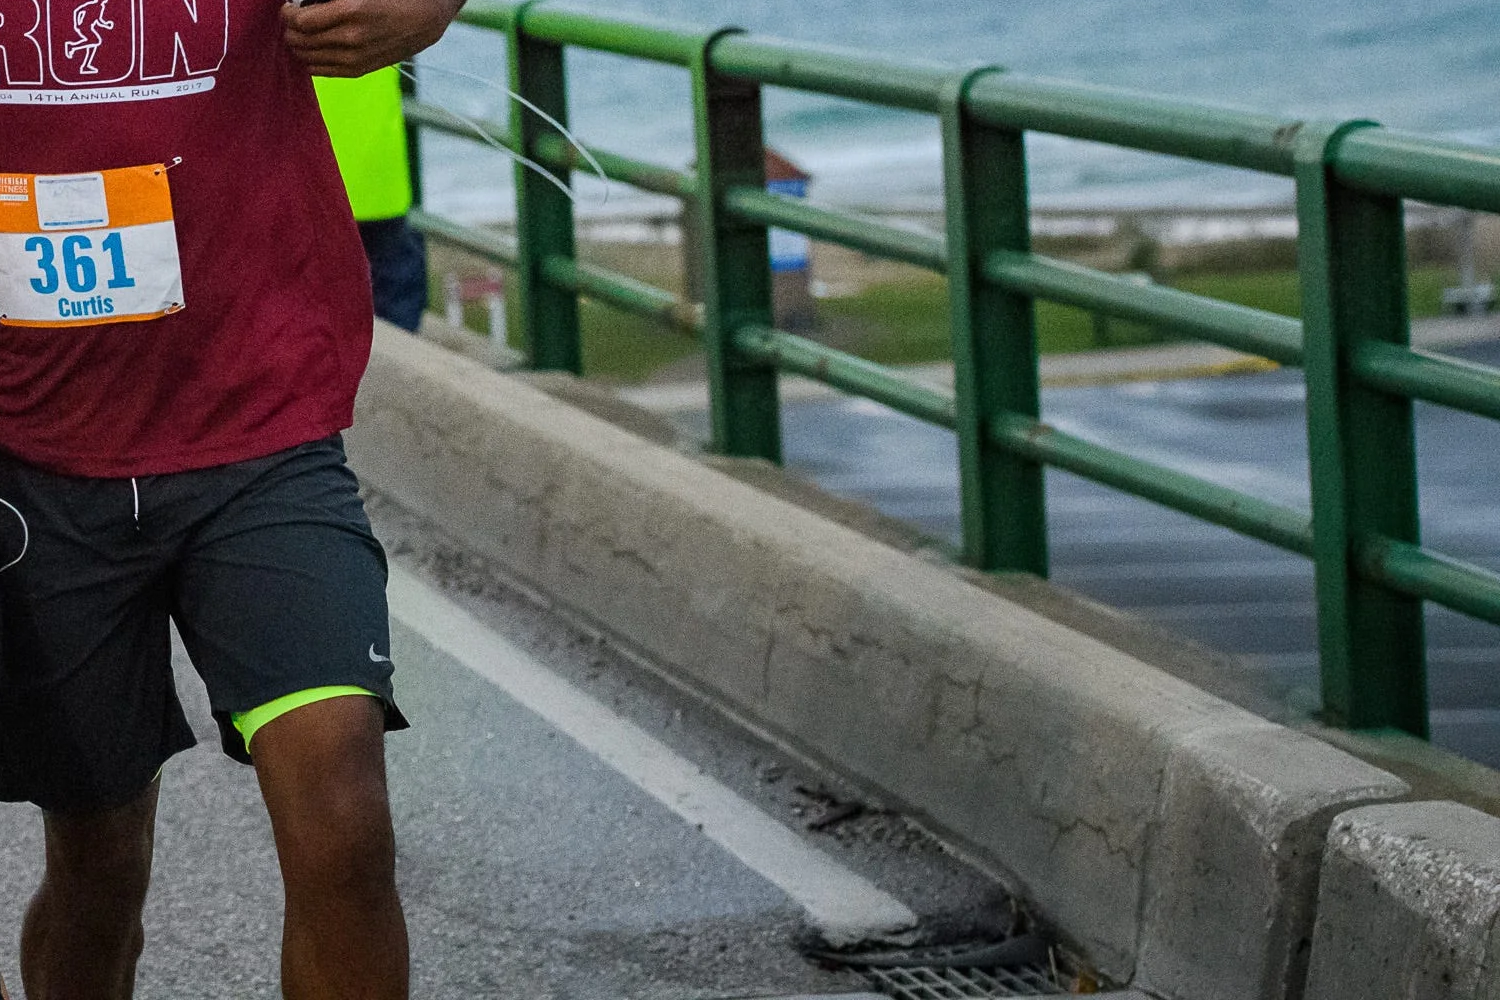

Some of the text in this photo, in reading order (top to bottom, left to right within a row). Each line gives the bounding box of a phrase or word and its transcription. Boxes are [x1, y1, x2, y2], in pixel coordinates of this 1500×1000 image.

[27, 92, 64, 102] 14TH
[69, 91, 125, 101] ANNUAL
[131, 88, 160, 98] RUN
[176, 82, 203, 92] 2017
[25, 232, 136, 295] 361
[58, 295, 115, 318] Curtis
